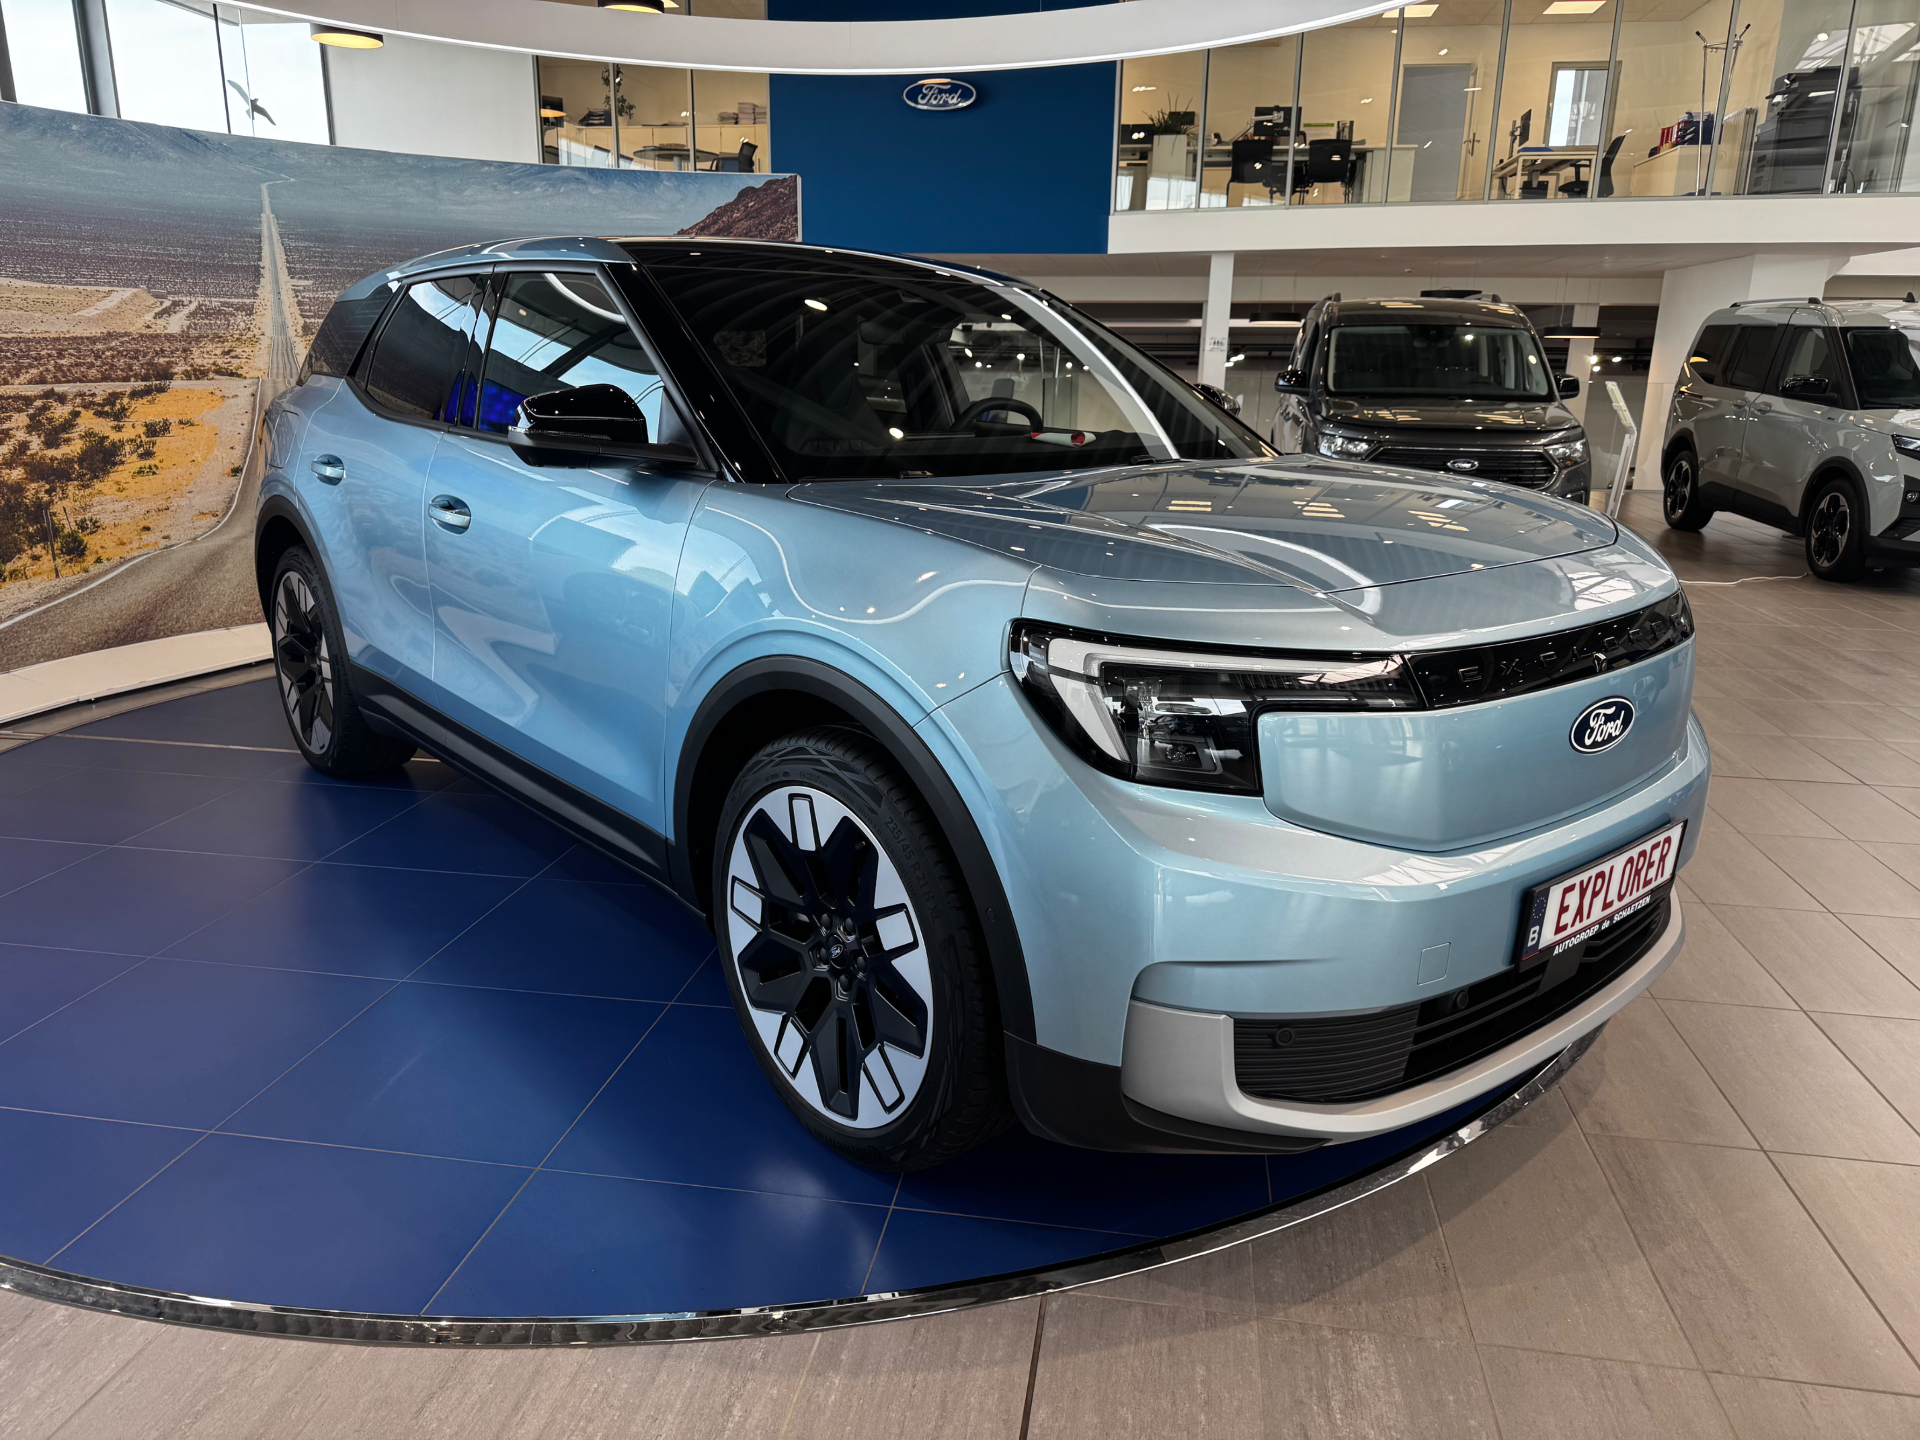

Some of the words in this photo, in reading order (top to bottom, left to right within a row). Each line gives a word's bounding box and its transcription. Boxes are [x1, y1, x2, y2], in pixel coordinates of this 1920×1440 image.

[918, 84, 962, 104] Ford
[1585, 706, 1625, 745] Ford
[884, 817, 916, 860] 235/45
[1554, 835, 1672, 936] EXPLORER
[1527, 925, 1540, 947] B
[1553, 924, 1600, 956] AUTOGROEP
[1601, 920, 1610, 930] de
[1613, 895, 1651, 923] SCHAETZEN
